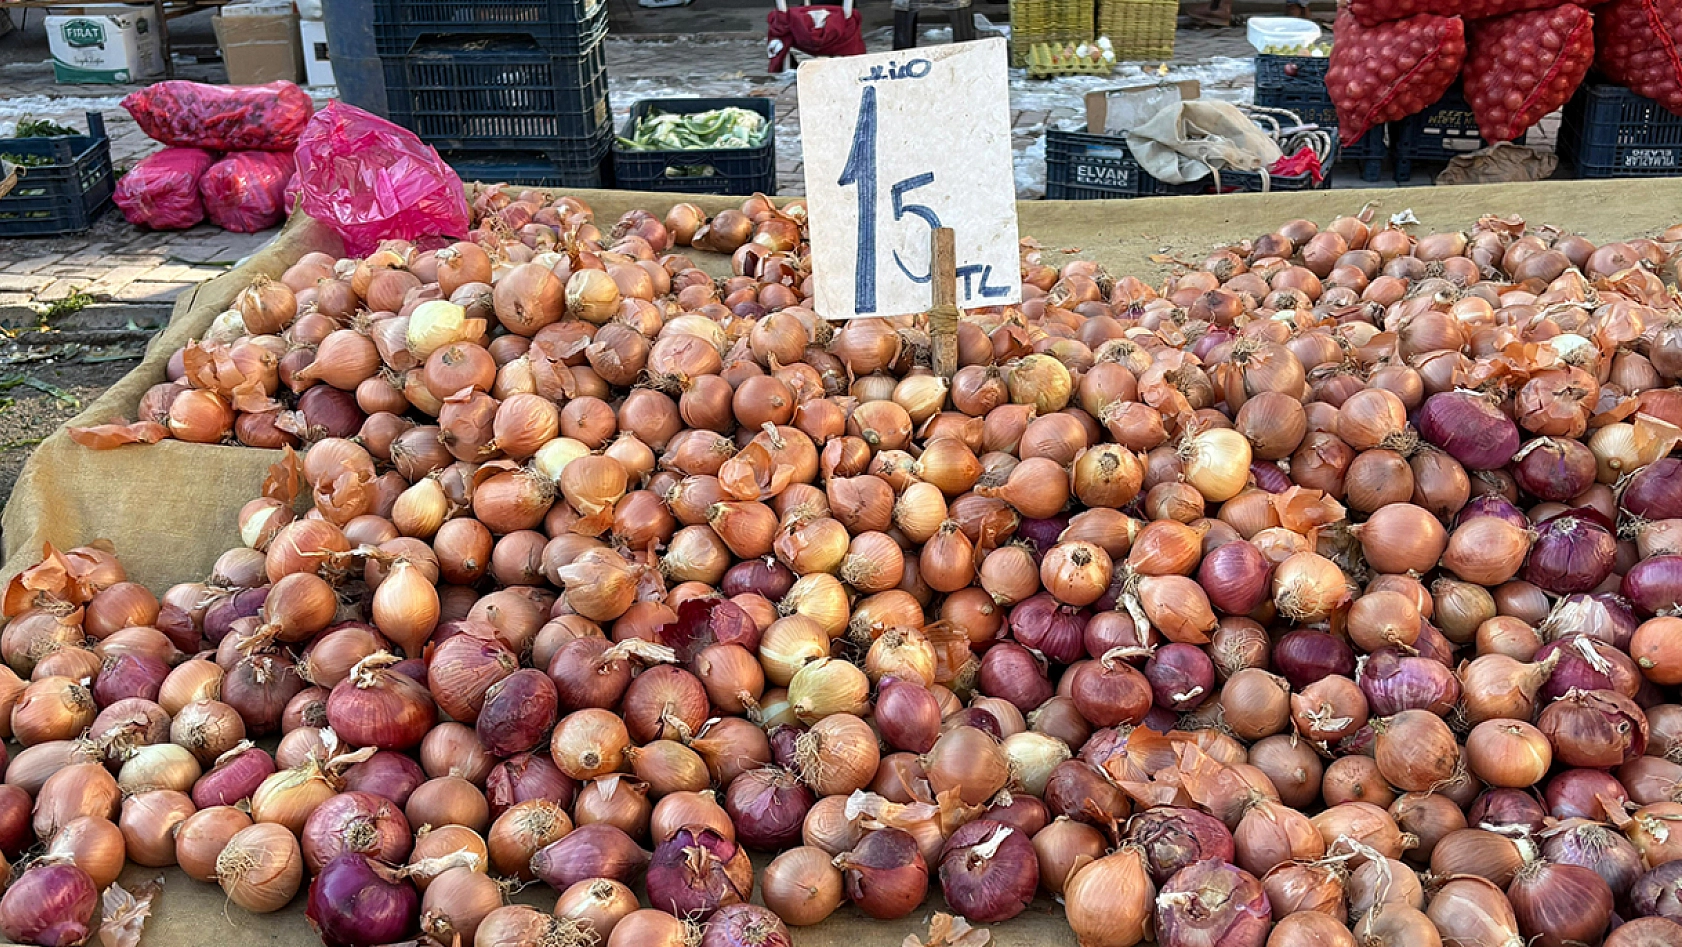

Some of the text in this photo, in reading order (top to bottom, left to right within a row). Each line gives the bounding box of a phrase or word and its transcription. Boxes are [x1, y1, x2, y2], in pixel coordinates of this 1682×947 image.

[66, 28, 100, 39] FIRAT
[1077, 165, 1128, 180] ELVAN
[837, 85, 1011, 315] 15 TL
